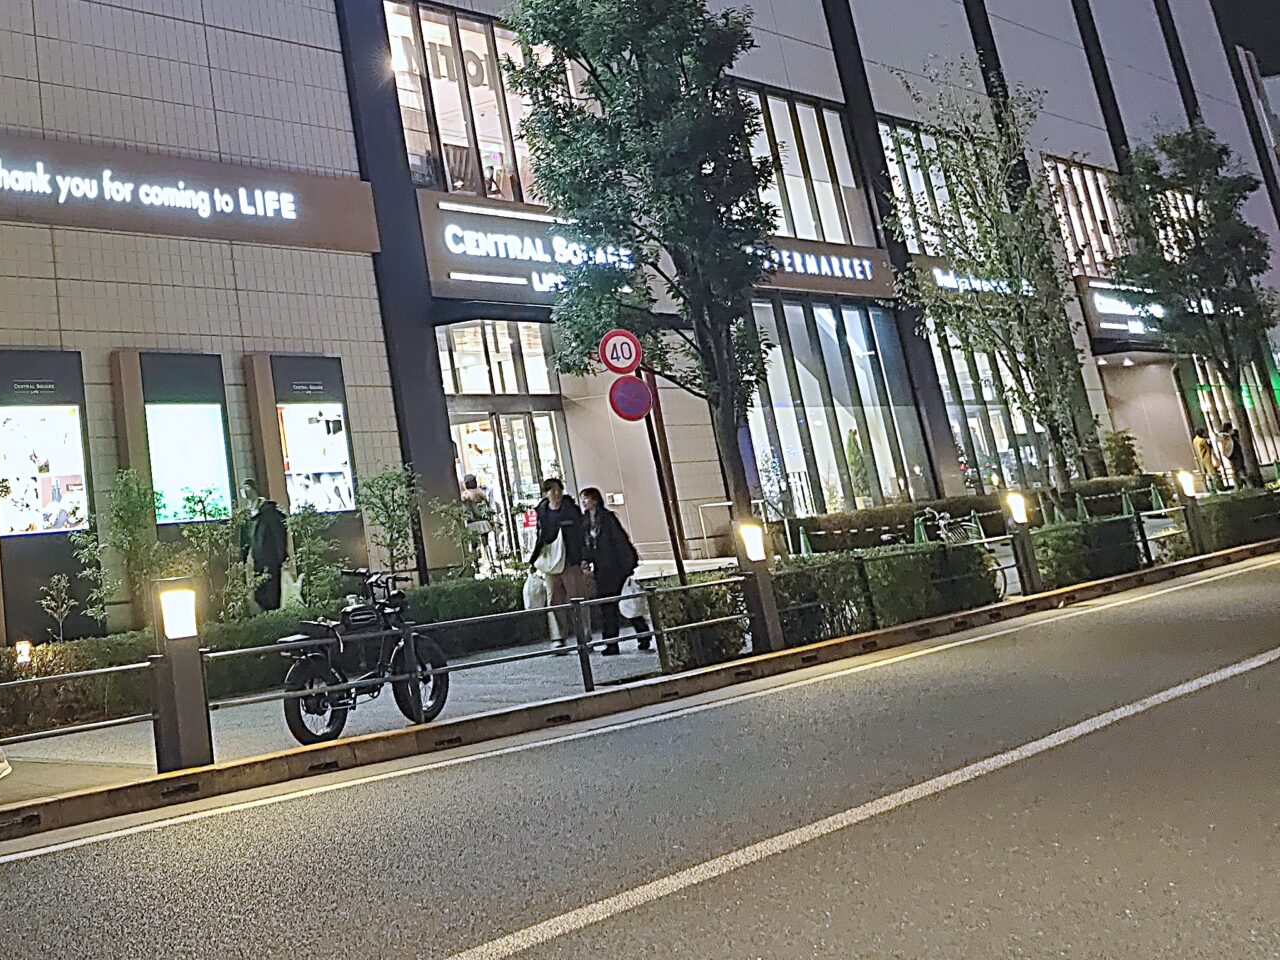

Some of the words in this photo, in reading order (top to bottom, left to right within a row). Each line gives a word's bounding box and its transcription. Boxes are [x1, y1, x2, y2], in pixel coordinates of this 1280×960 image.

[56, 174, 97, 204] you
[102, 169, 133, 203] for
[139, 181, 210, 218] coming
[214, 188, 234, 214] to
[239, 187, 297, 220] LIFE
[444, 224, 552, 263] CENTRAL
[610, 341, 633, 362] 40
